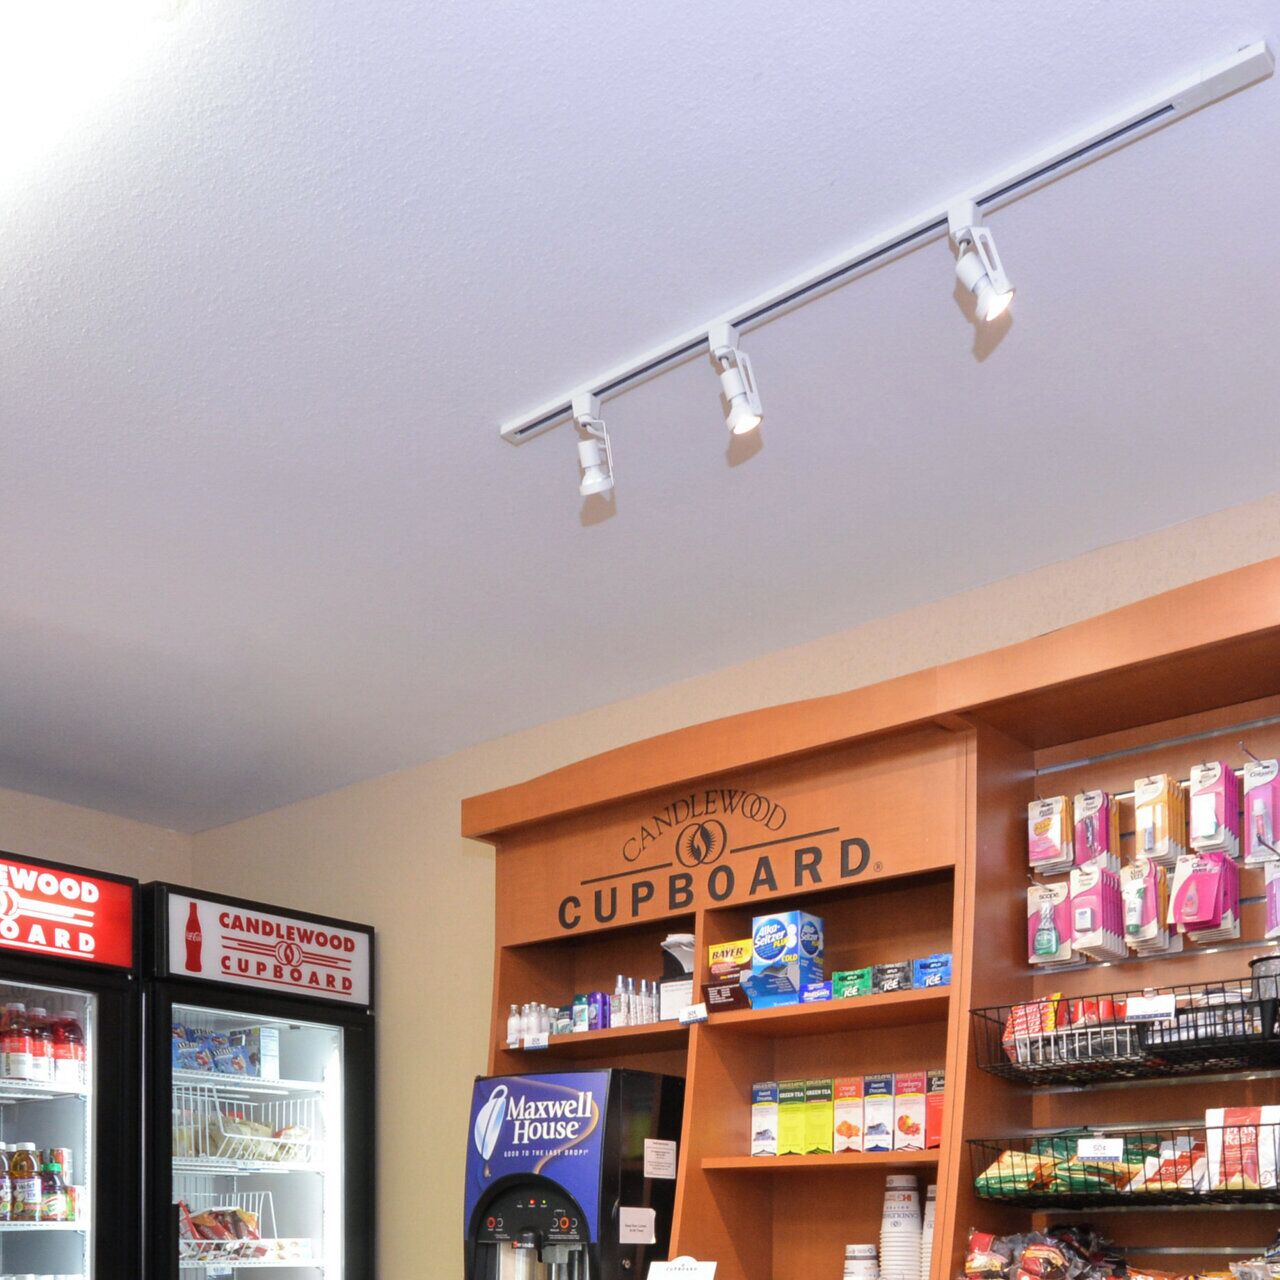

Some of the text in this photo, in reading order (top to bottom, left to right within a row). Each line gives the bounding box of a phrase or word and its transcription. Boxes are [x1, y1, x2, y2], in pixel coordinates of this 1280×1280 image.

[622, 789, 787, 862] CANDLEWOOD
[559, 837, 871, 930] CUPBOARD
[1037, 891, 1060, 901] scope
[219, 911, 355, 953] CANDLEWOOD
[759, 923, 781, 935] Alka-
[753, 930, 787, 947] Seltzer
[712, 946, 744, 960] BAYER
[782, 953, 799, 962] COLD
[221, 954, 352, 992] CUPBOARD
[779, 1091, 794, 1099] GREEN
[806, 1089, 820, 1097] GREEN
[506, 1091, 593, 1121] Maxwell
[512, 1119, 581, 1144] House
[532, 1149, 544, 1157] THE
[546, 1149, 561, 1157] LAST
